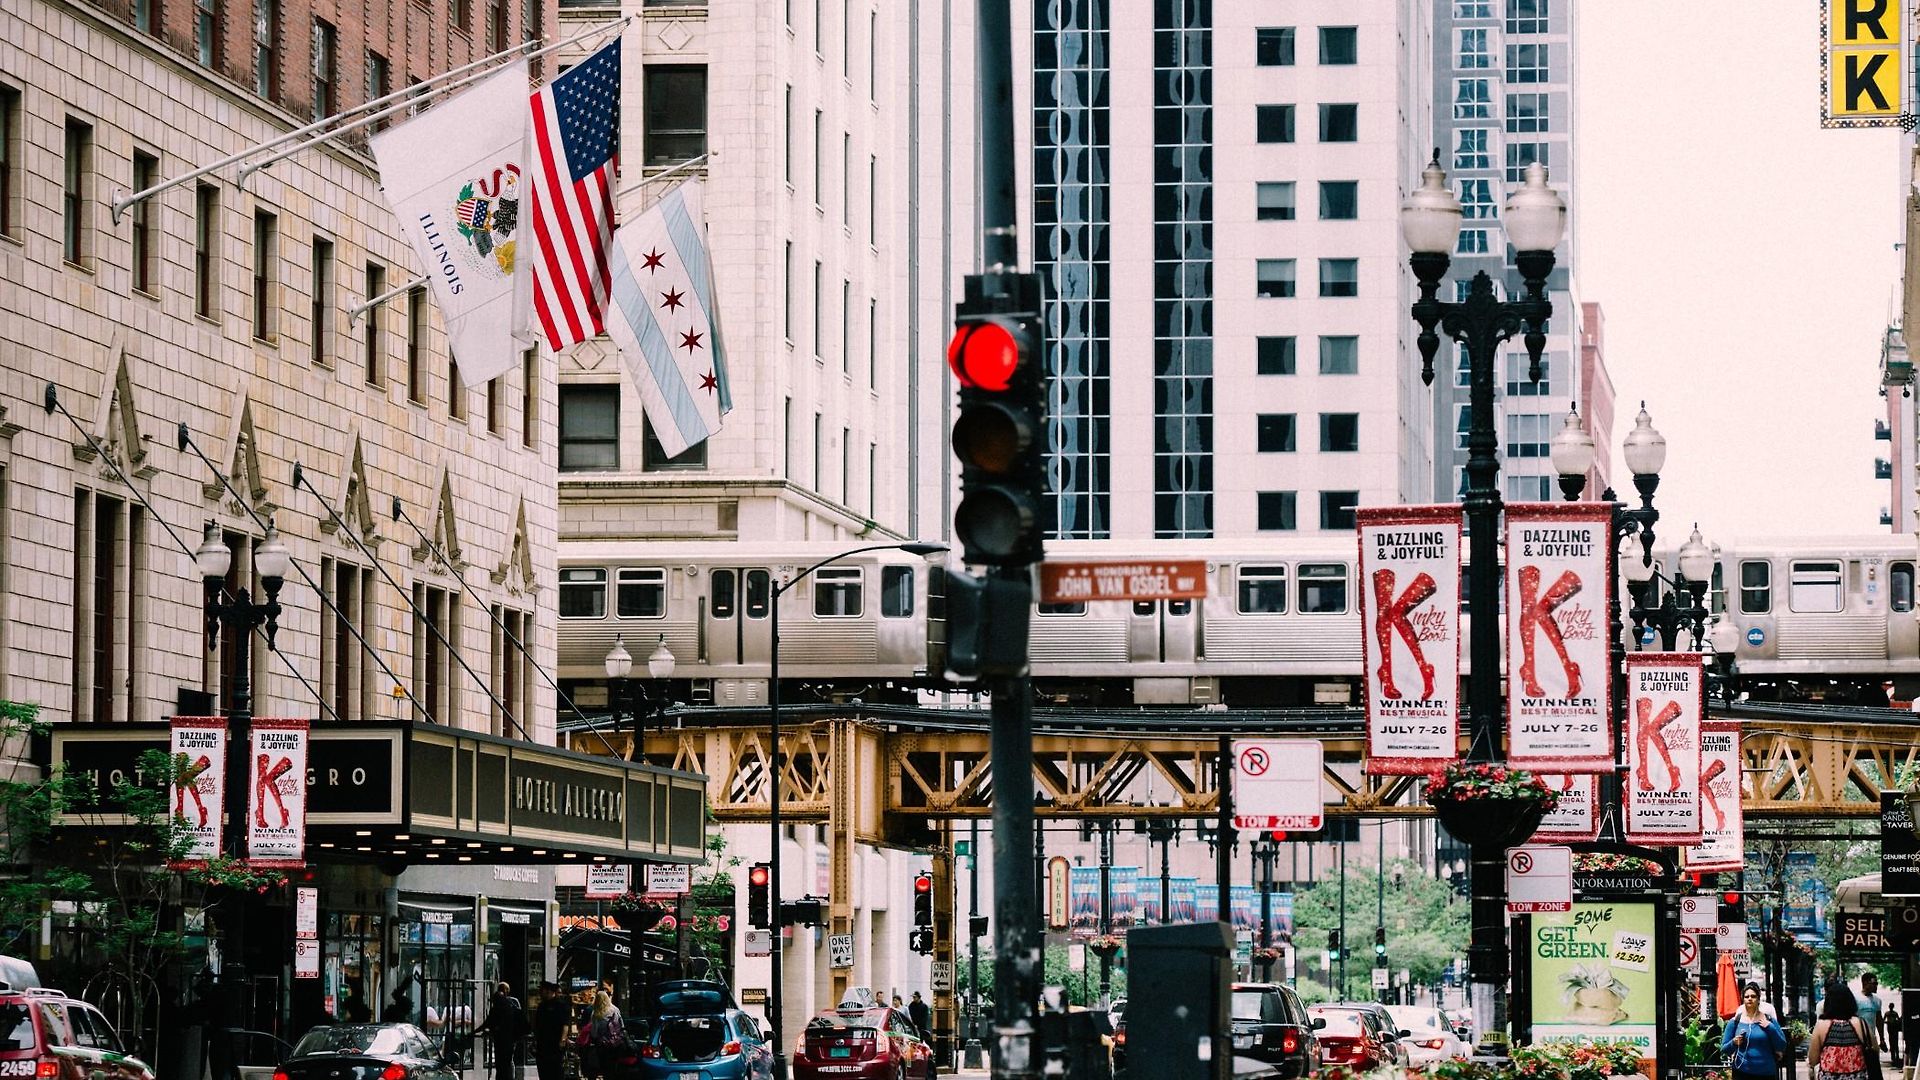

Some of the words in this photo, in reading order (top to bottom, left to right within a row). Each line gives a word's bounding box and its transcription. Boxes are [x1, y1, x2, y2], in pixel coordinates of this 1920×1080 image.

[420, 214, 464, 295] ILLINOIS
[1377, 547, 1387, 560] &
[1523, 545, 1533, 557] &
[1093, 567, 1152, 576] HONORARY
[1056, 577, 1092, 597] JOHN
[1097, 576, 1125, 595] VAN
[1129, 575, 1172, 595] OSDEL
[1176, 578, 1196, 591] WAY
[1640, 671, 1689, 682] DAZZLING
[1640, 682, 1647, 692] &
[1379, 699, 1448, 709] WINNER!
[1521, 698, 1598, 707] WINNER!
[1380, 709, 1405, 717] BEST
[1407, 709, 1448, 717] MUSICAL
[1380, 725, 1415, 735] JULY
[1418, 725, 1447, 735] 7-26
[1521, 724, 1560, 733] JULY
[1565, 724, 1598, 733] 7-26
[179, 732, 217, 740] DAZZLING
[261, 734, 299, 742] DAZZLING
[1702, 735, 1731, 745] ZZLING
[87, 769, 166, 786] HOTE
[516, 776, 557, 814] HOTEL
[565, 783, 622, 823] ALLEGRO
[1637, 791, 1692, 799] WINNER!
[1561, 808, 1585, 816] 7-26
[1240, 816, 1269, 828] TOW
[1276, 816, 1314, 828] ZONE
[1882, 814, 1910, 822] RANDO
[493, 866, 521, 881] STARBUCKS
[522, 868, 539, 883] COFFEE
[1572, 878, 1652, 888] NFORMATION
[1511, 903, 1533, 911] TOW
[1538, 902, 1566, 911] ZONE
[1574, 907, 1613, 925] SOME
[1538, 926, 1578, 943] GET
[831, 937, 850, 945] ONE
[1843, 934, 1891, 947] PARK
[832, 946, 851, 954] WAY
[1538, 942, 1609, 959] GREEN.
[0, 1061, 37, 1076] 2459
